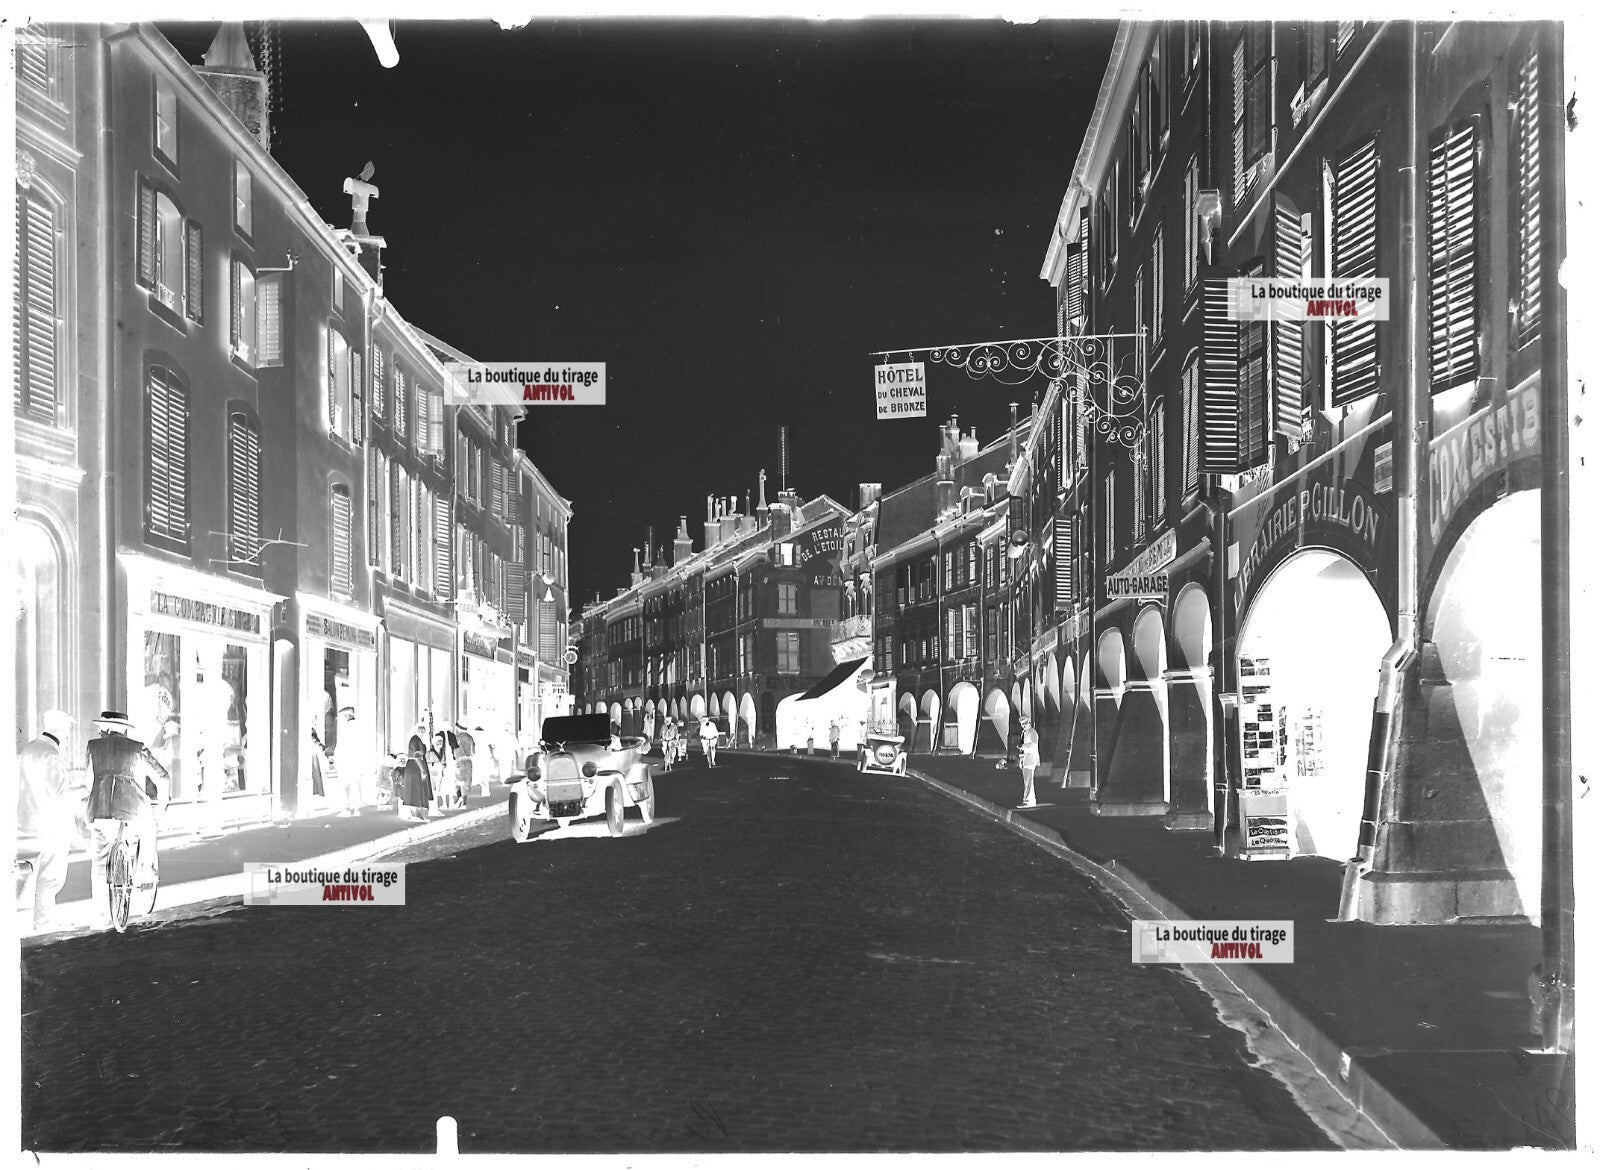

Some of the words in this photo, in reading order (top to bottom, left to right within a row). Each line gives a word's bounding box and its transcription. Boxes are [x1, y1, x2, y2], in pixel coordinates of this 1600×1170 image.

[877, 366, 924, 385] HÔTEL
[877, 391, 887, 399] DU
[889, 386, 925, 398] CHEVAL
[878, 406, 888, 414] DE
[890, 401, 925, 413] BRONZE
[801, 549, 813, 562] DE
[1234, 495, 1297, 617] LIBRAIRIE
[1107, 575, 1168, 596] AUTO-GARAGE
